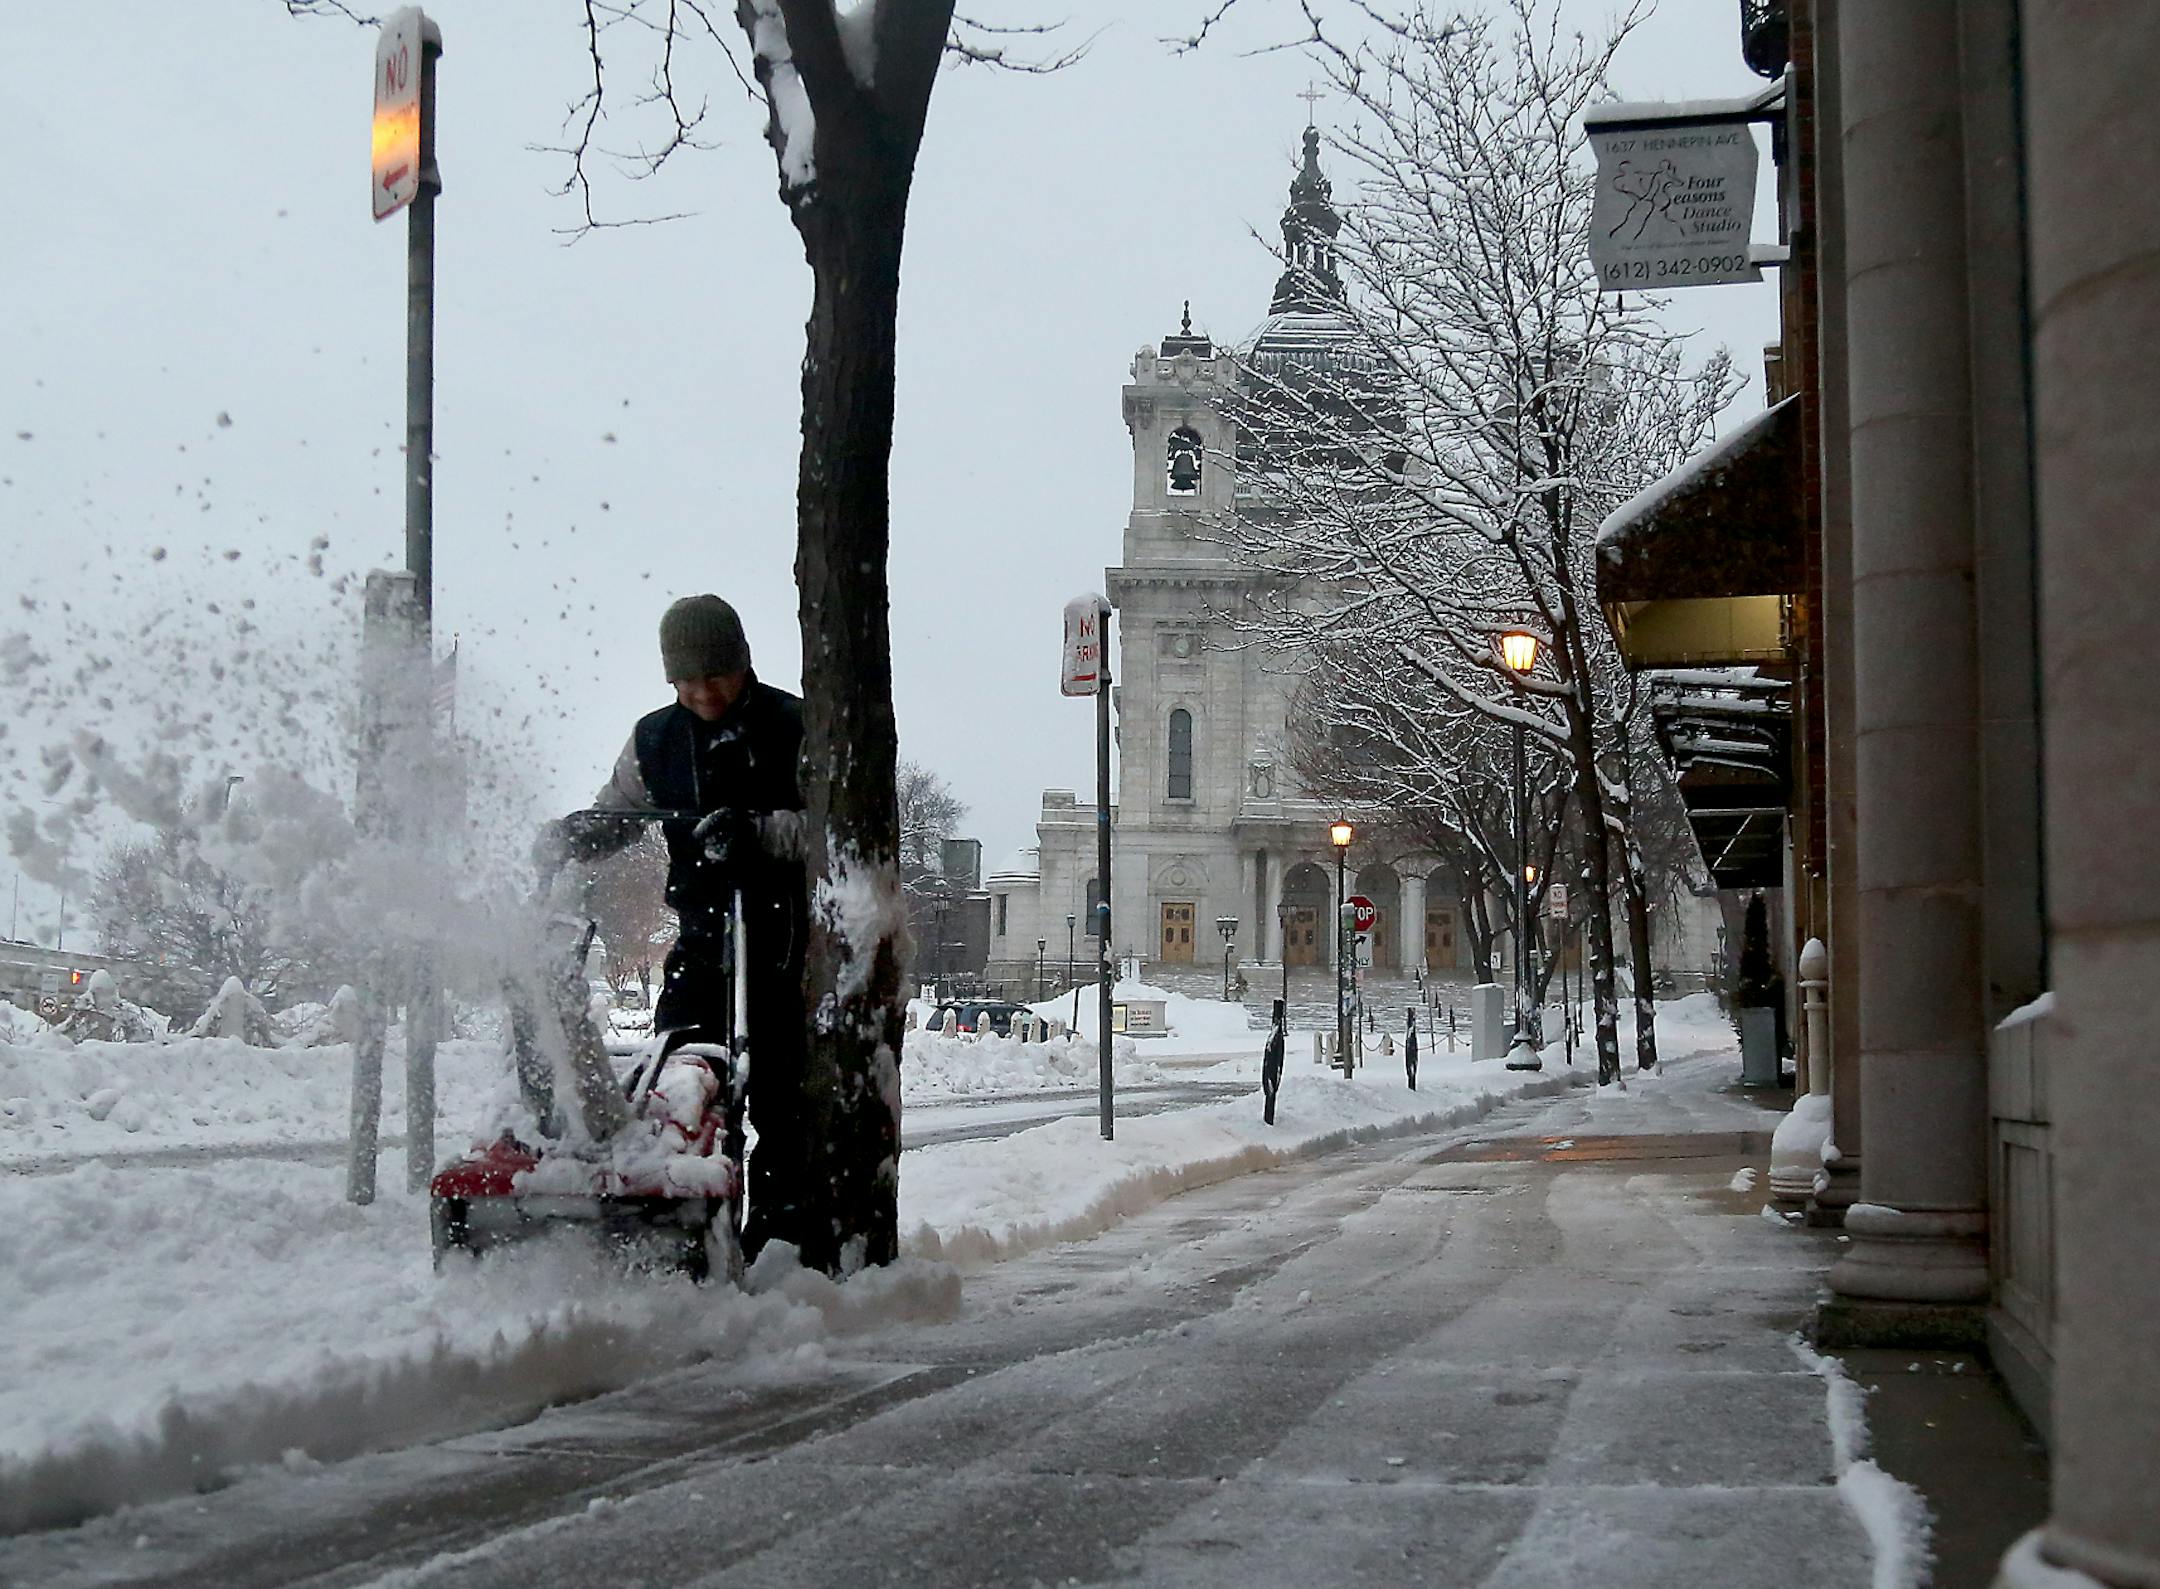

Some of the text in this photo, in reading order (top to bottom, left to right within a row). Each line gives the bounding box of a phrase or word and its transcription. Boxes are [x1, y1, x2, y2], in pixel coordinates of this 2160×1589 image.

[386, 46, 408, 99] NO
[1605, 140, 1636, 154] 1637
[1716, 132, 1739, 146] AVE
[1687, 176, 1725, 190] Four
[1683, 207, 1732, 219] Dance
[1693, 219, 1741, 234] Studio
[1603, 255, 1746, 281] (612) 342-0902
[1354, 956, 1370, 966] NLY
